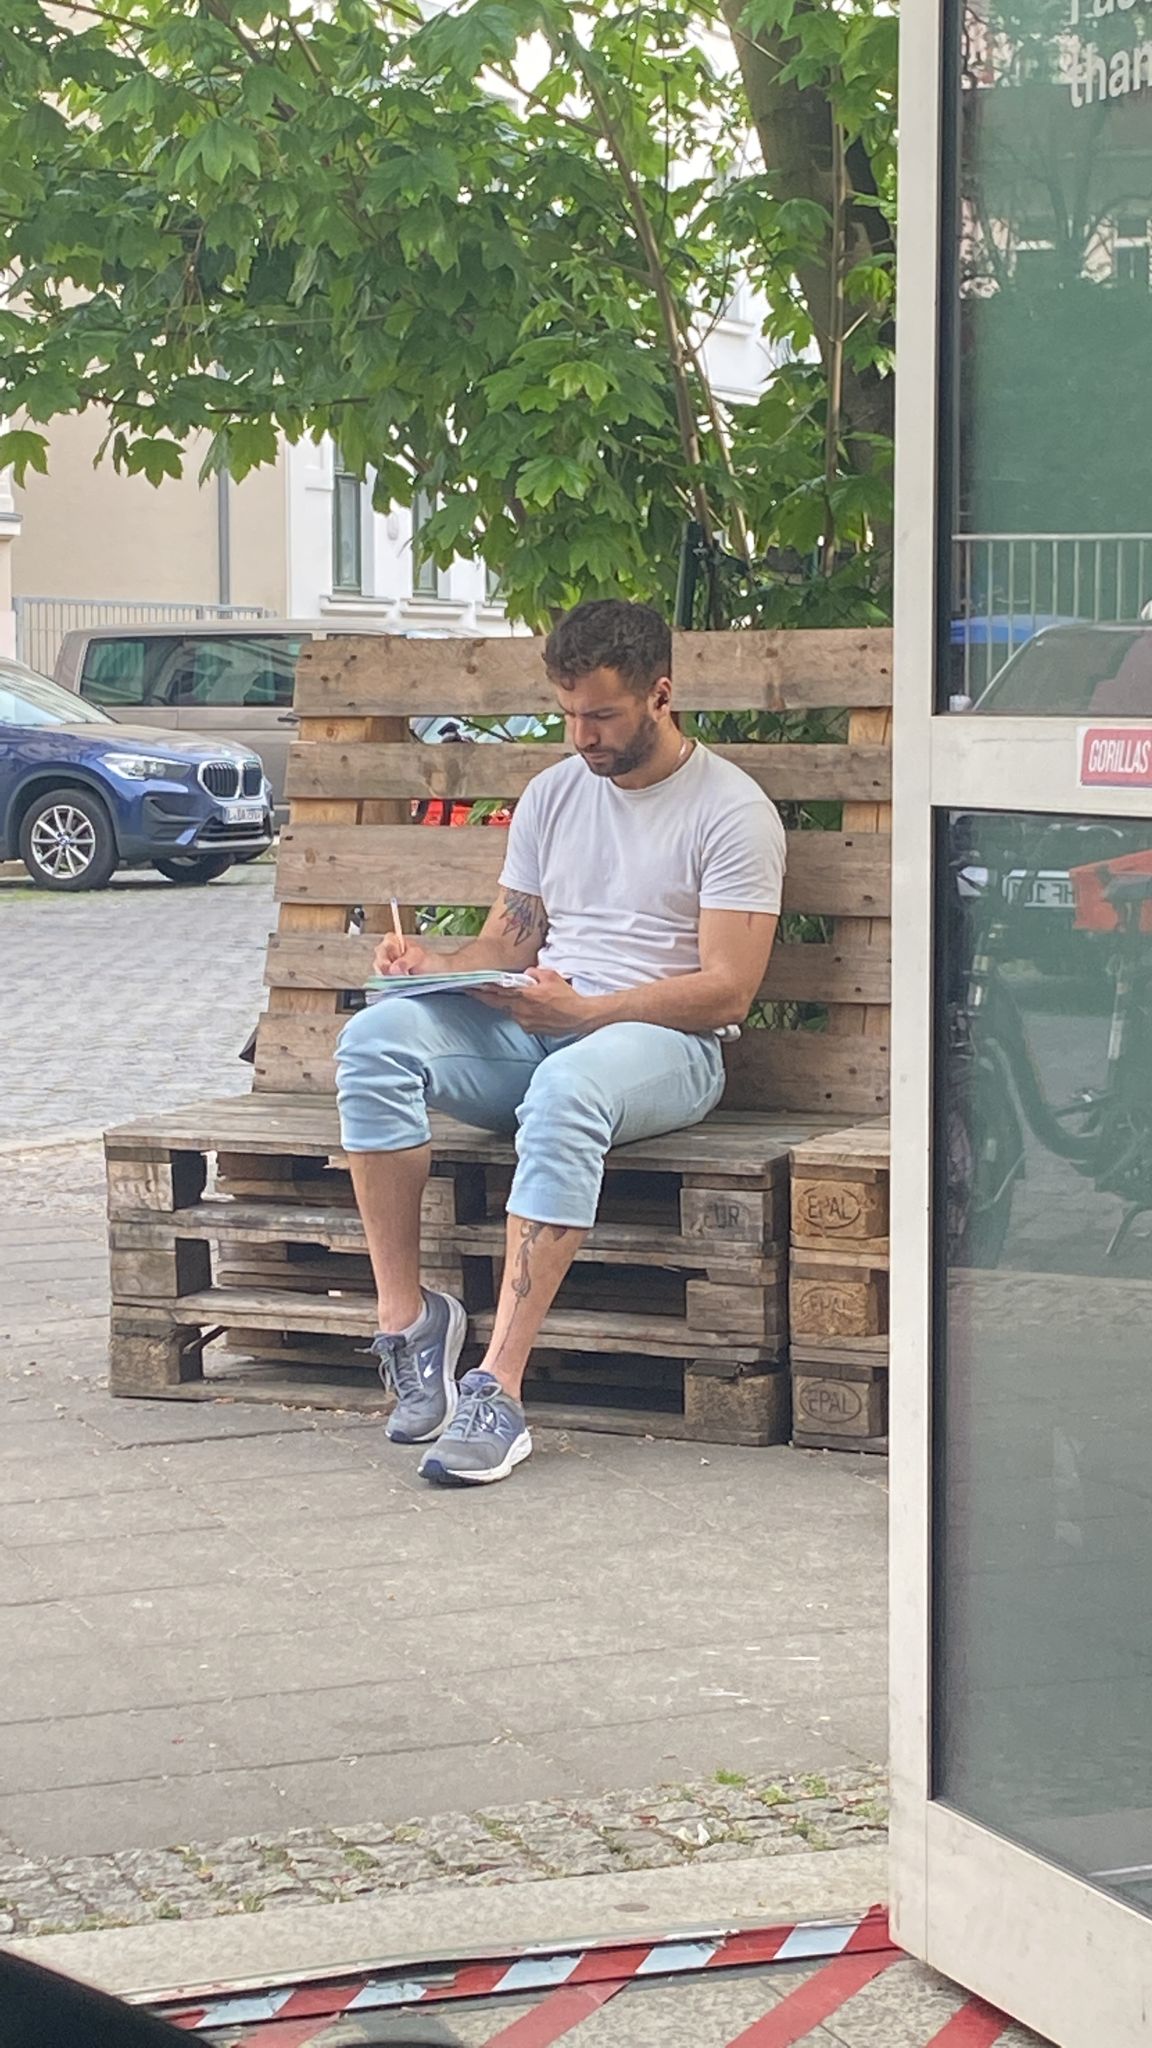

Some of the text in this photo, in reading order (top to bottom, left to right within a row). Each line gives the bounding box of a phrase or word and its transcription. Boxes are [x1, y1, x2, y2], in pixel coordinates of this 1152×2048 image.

[1088, 739, 1152, 773] GORILLAS
[807, 1195, 852, 1220] EPAL
[807, 1389, 854, 1415] EPAL
